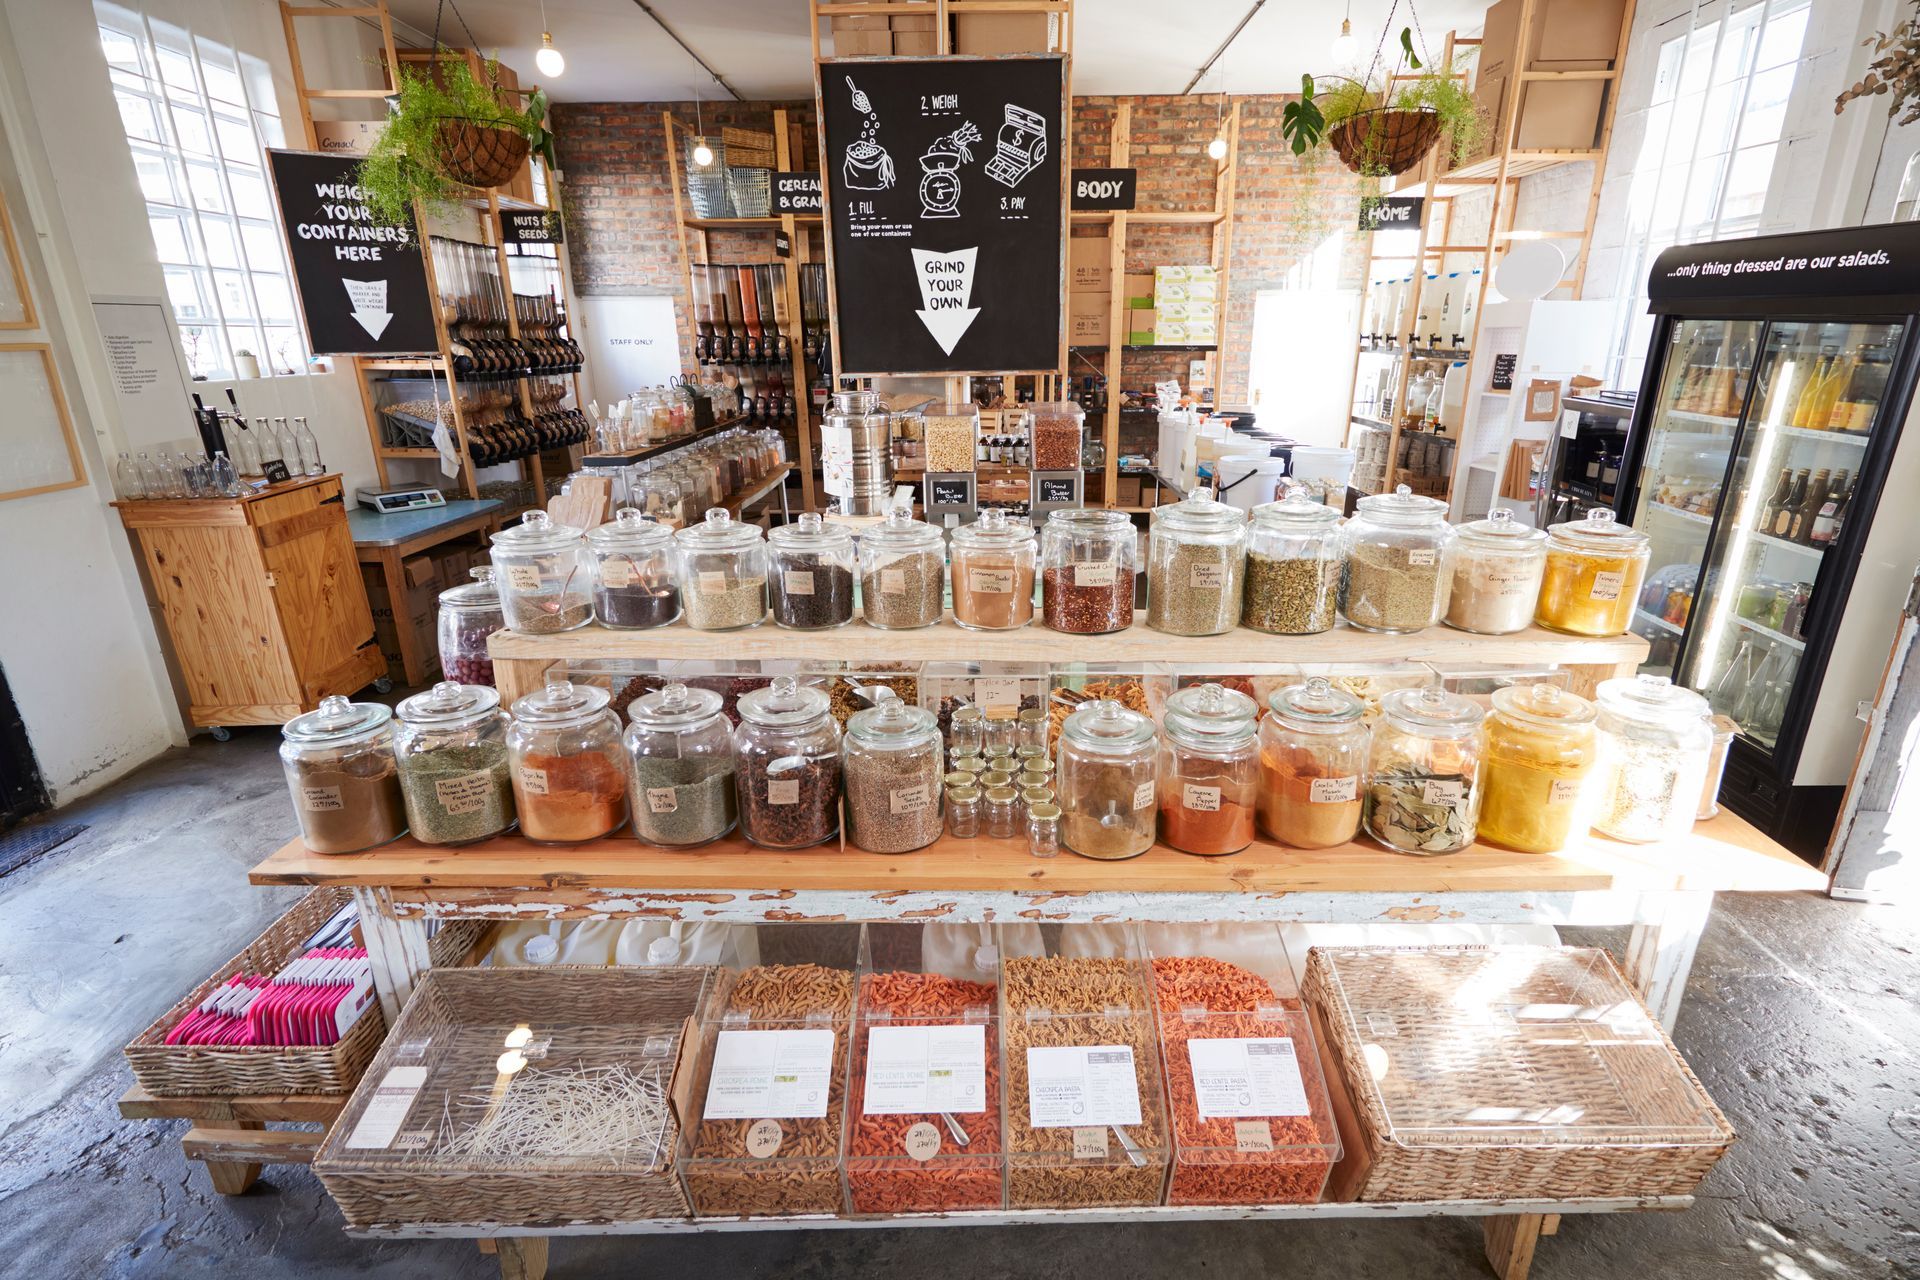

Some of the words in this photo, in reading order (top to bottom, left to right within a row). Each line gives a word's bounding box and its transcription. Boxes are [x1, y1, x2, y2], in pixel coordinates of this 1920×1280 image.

[921, 96, 929, 110] 2.
[932, 94, 958, 109] WEIGH
[1076, 178, 1124, 200] BODY
[780, 196, 790, 208] &
[860, 201, 874, 214] FILL
[1000, 198, 1008, 210] 3.
[1011, 197, 1026, 209] PAY
[322, 205, 372, 221] YOUR
[1368, 206, 1412, 221] HOME
[514, 216, 539, 226] NUTS
[542, 217, 550, 226] &
[297, 223, 410, 242] CONTAINERS
[519, 229, 548, 239] SEEDS
[335, 246, 382, 261] HERE
[925, 261, 965, 274] GRIND
[1667, 262, 1700, 279] ...only
[1701, 261, 1732, 277] thing
[1734, 256, 1784, 273] dressed
[1785, 258, 1807, 271] are
[1810, 255, 1836, 269] our
[1838, 249, 1890, 267] salads.
[928, 279, 963, 292] YOUR
[930, 298, 963, 310] OWN
[1488, 575, 1510, 584] Ginger
[519, 768, 544, 780] Paprika
[438, 782, 462, 790] Mixed
[1188, 786, 1213, 796] Cayenne
[1429, 782, 1443, 792] Bay
[648, 791, 669, 802] Thyme
[896, 789, 924, 799] Coriander
[373, 1096, 410, 1107] Spaghetti
